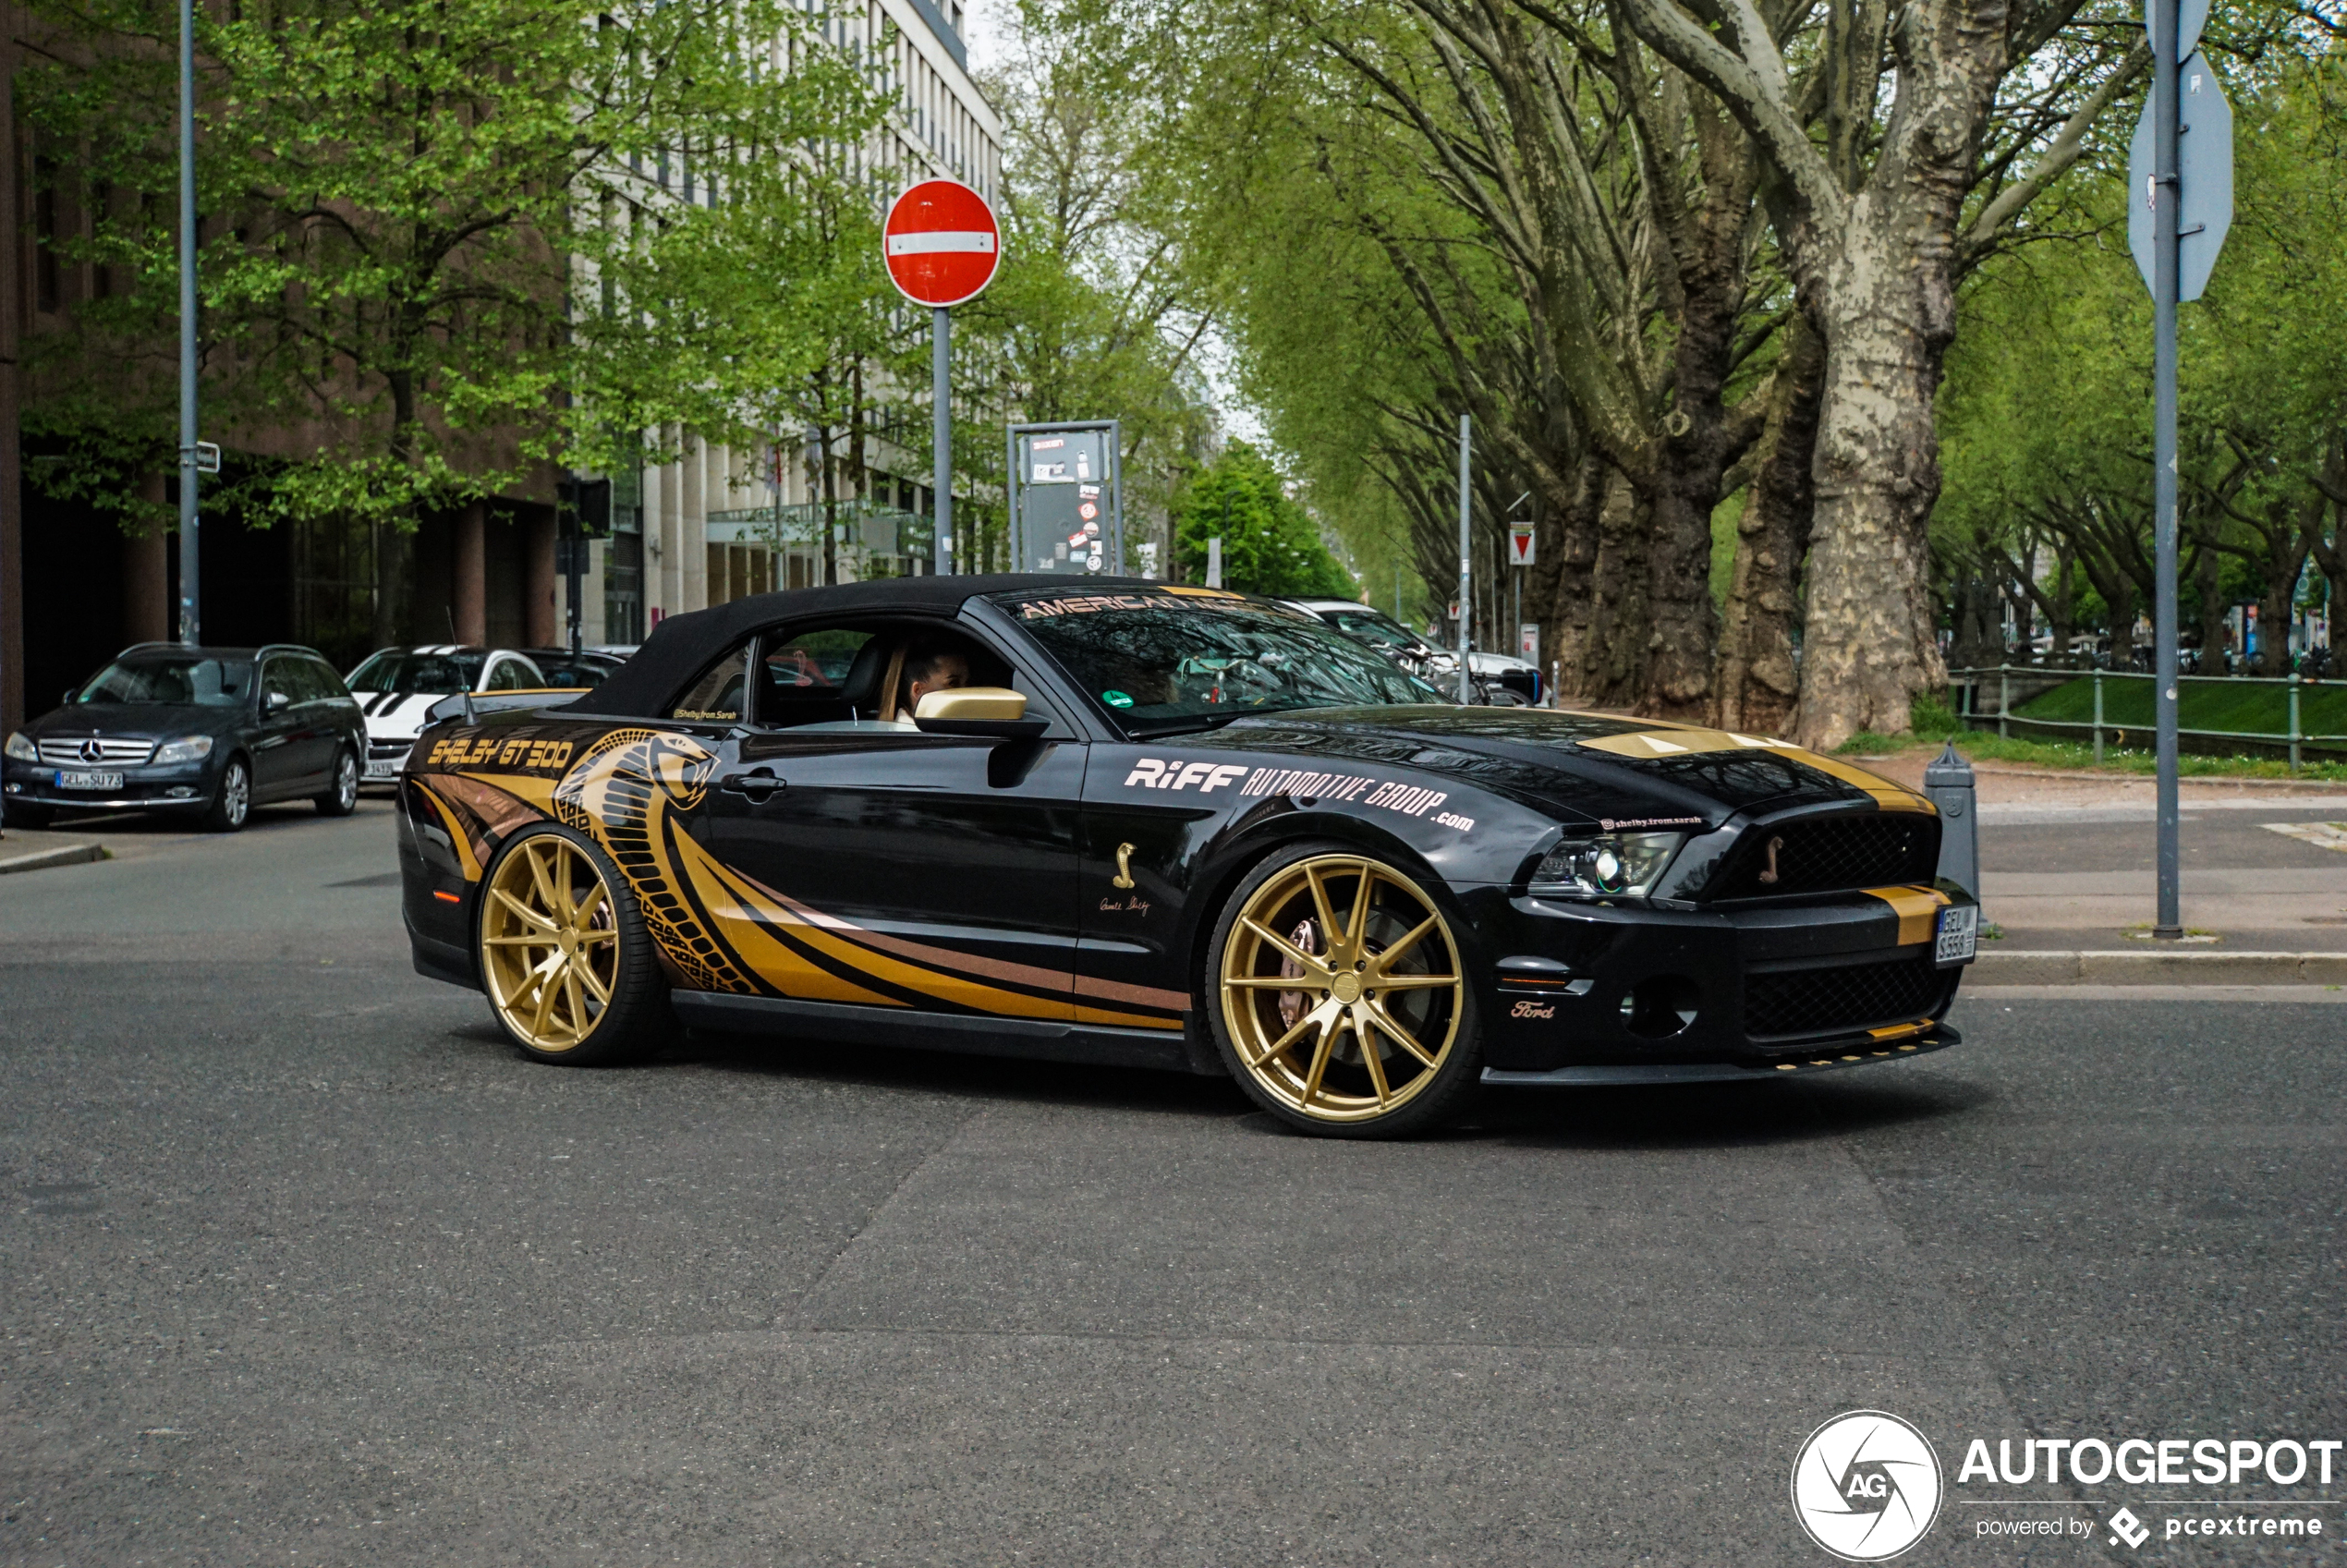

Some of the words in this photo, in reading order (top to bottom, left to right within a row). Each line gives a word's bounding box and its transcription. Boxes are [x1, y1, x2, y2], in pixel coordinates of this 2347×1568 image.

[1021, 596, 1189, 619] AMERICAN
[427, 739, 503, 764] SHELBY
[499, 740, 532, 765] GT
[526, 740, 573, 768] 500
[1239, 767, 1376, 801] AUTOMOTIVE
[1364, 782, 1448, 817] GROUP
[1429, 811, 1476, 833] .com
[1615, 816, 1702, 828] shelby.from.sarah
[1944, 910, 1962, 933] GEL
[1510, 1000, 1556, 1019] Ford
